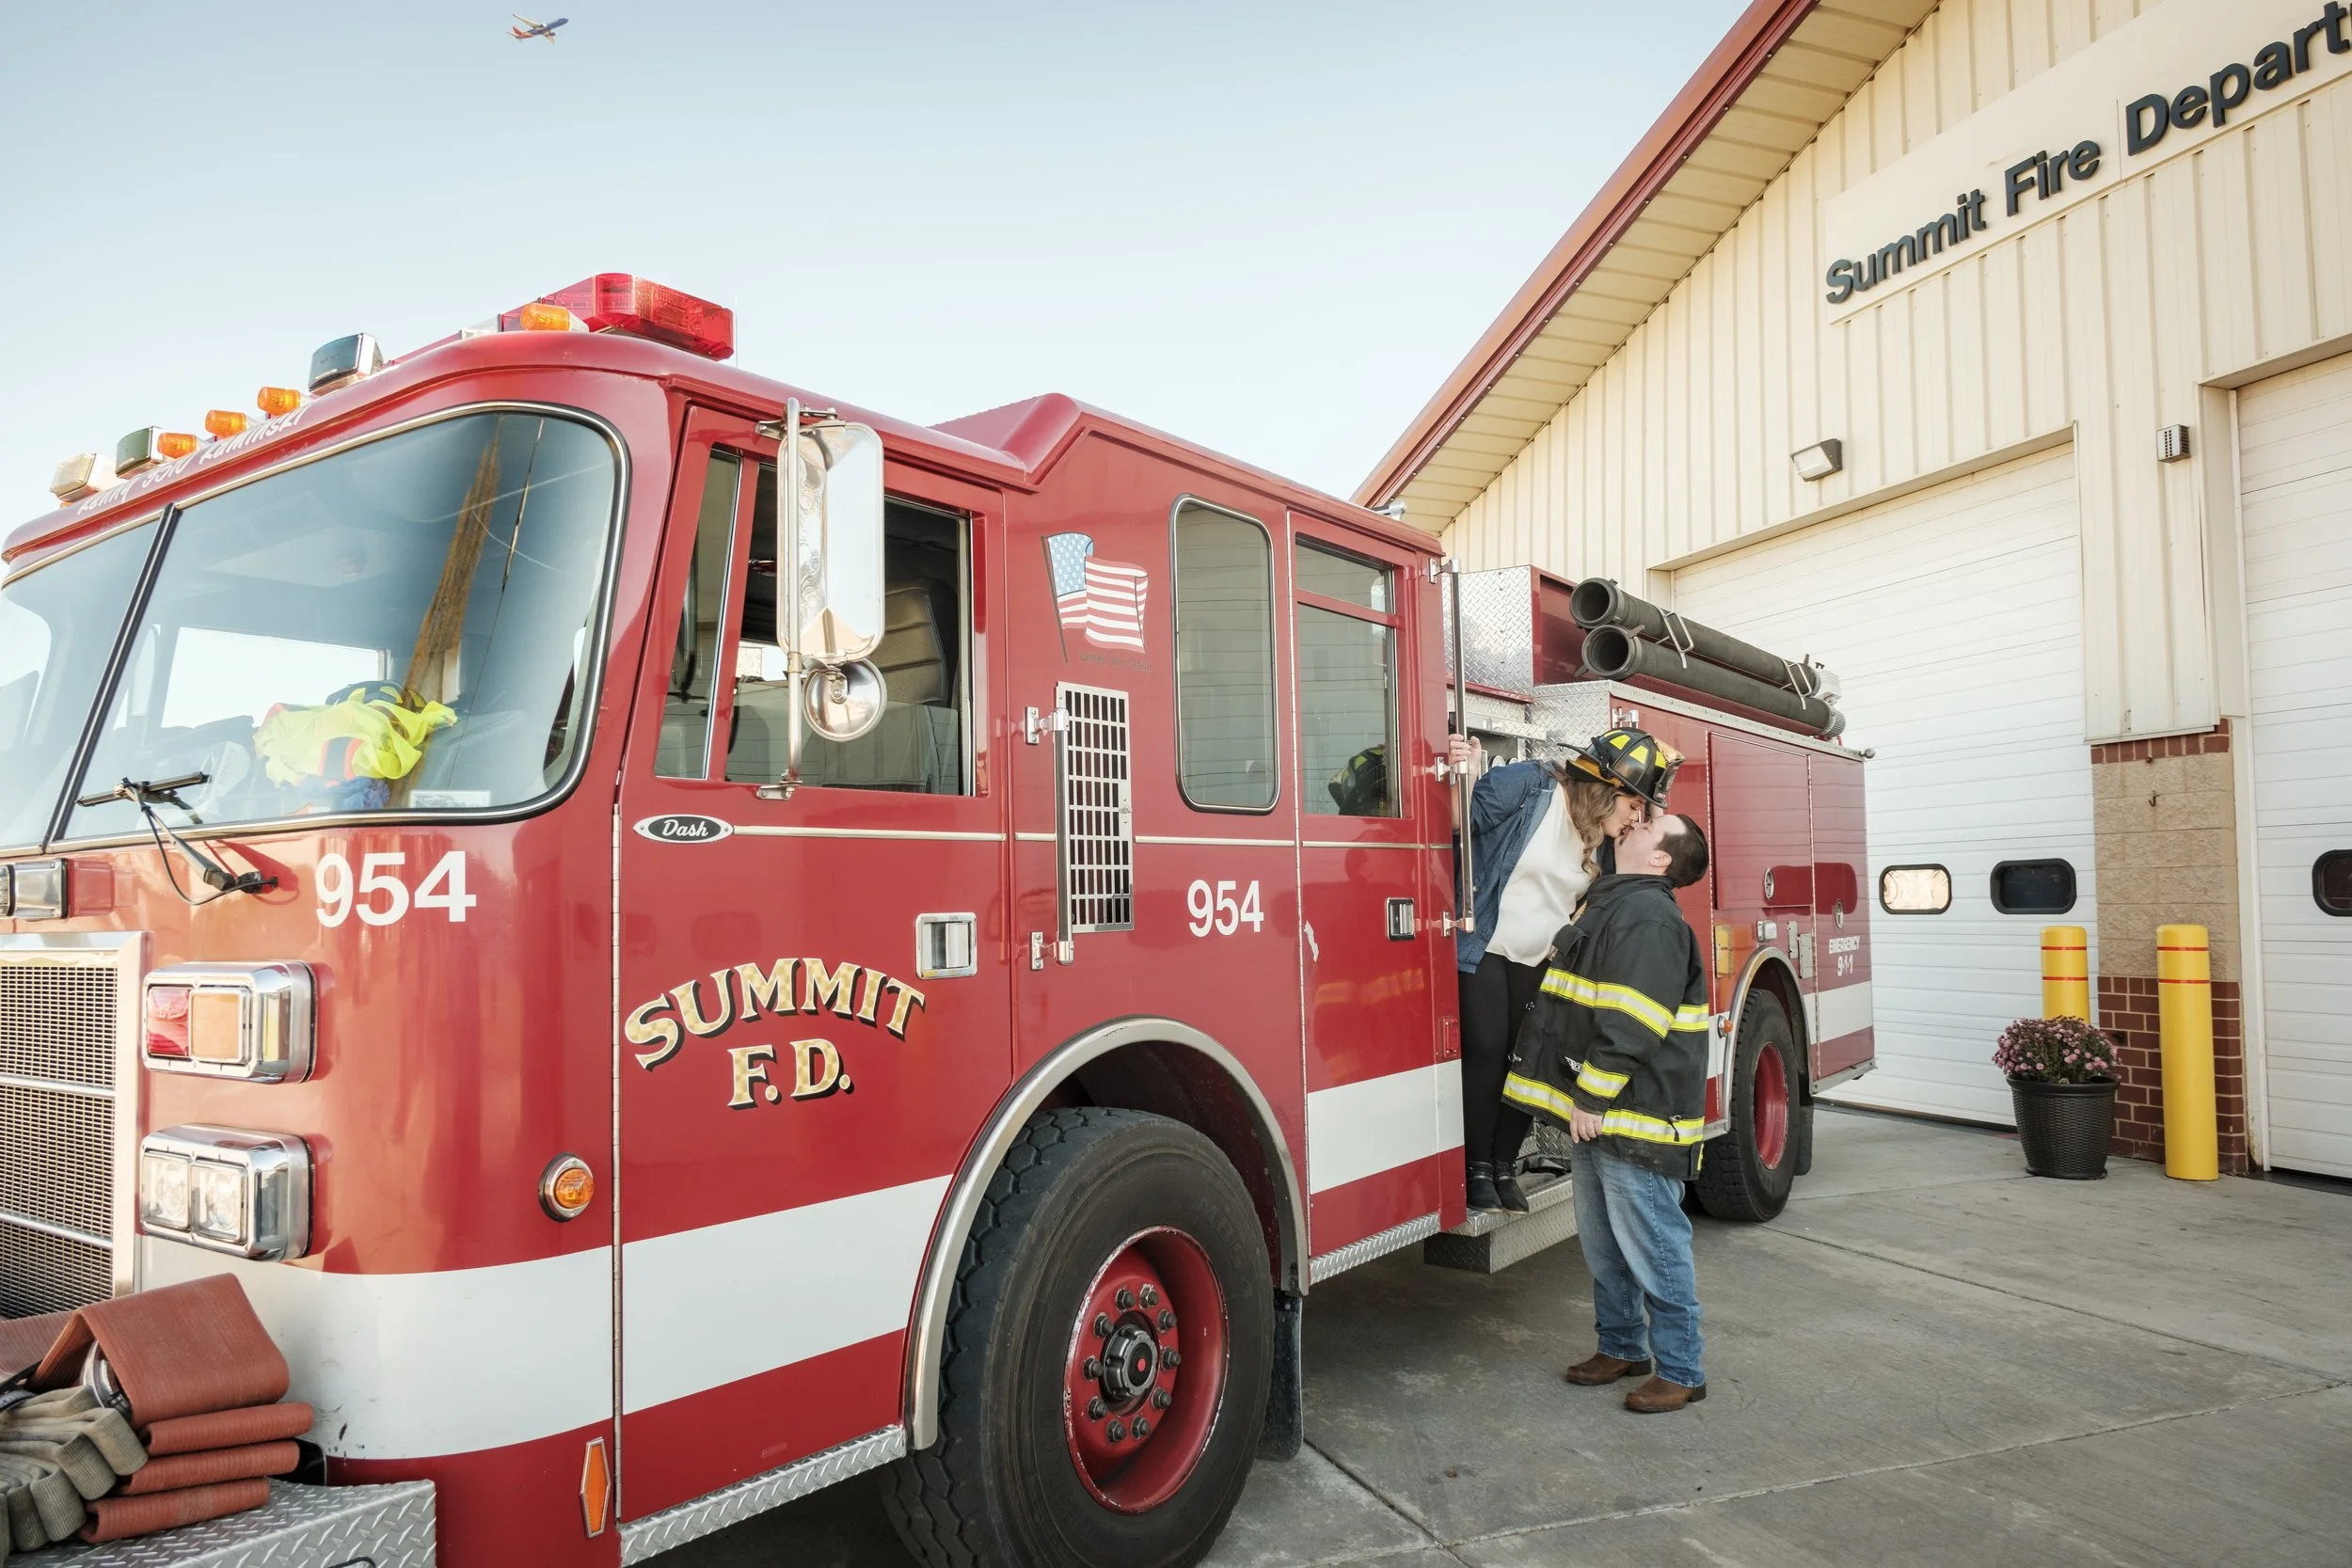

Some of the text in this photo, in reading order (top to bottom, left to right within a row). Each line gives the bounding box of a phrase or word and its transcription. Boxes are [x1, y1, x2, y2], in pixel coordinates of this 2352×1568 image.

[1826, 1, 2352, 305] Summit Fire Depart
[1128, 659, 1152, 672] Stand
[661, 818, 708, 836] Dash
[315, 850, 477, 927] 954
[1187, 879, 1264, 938] 954
[1828, 934, 1860, 954] EMERGENCY
[625, 958, 926, 1070] SUMMIT
